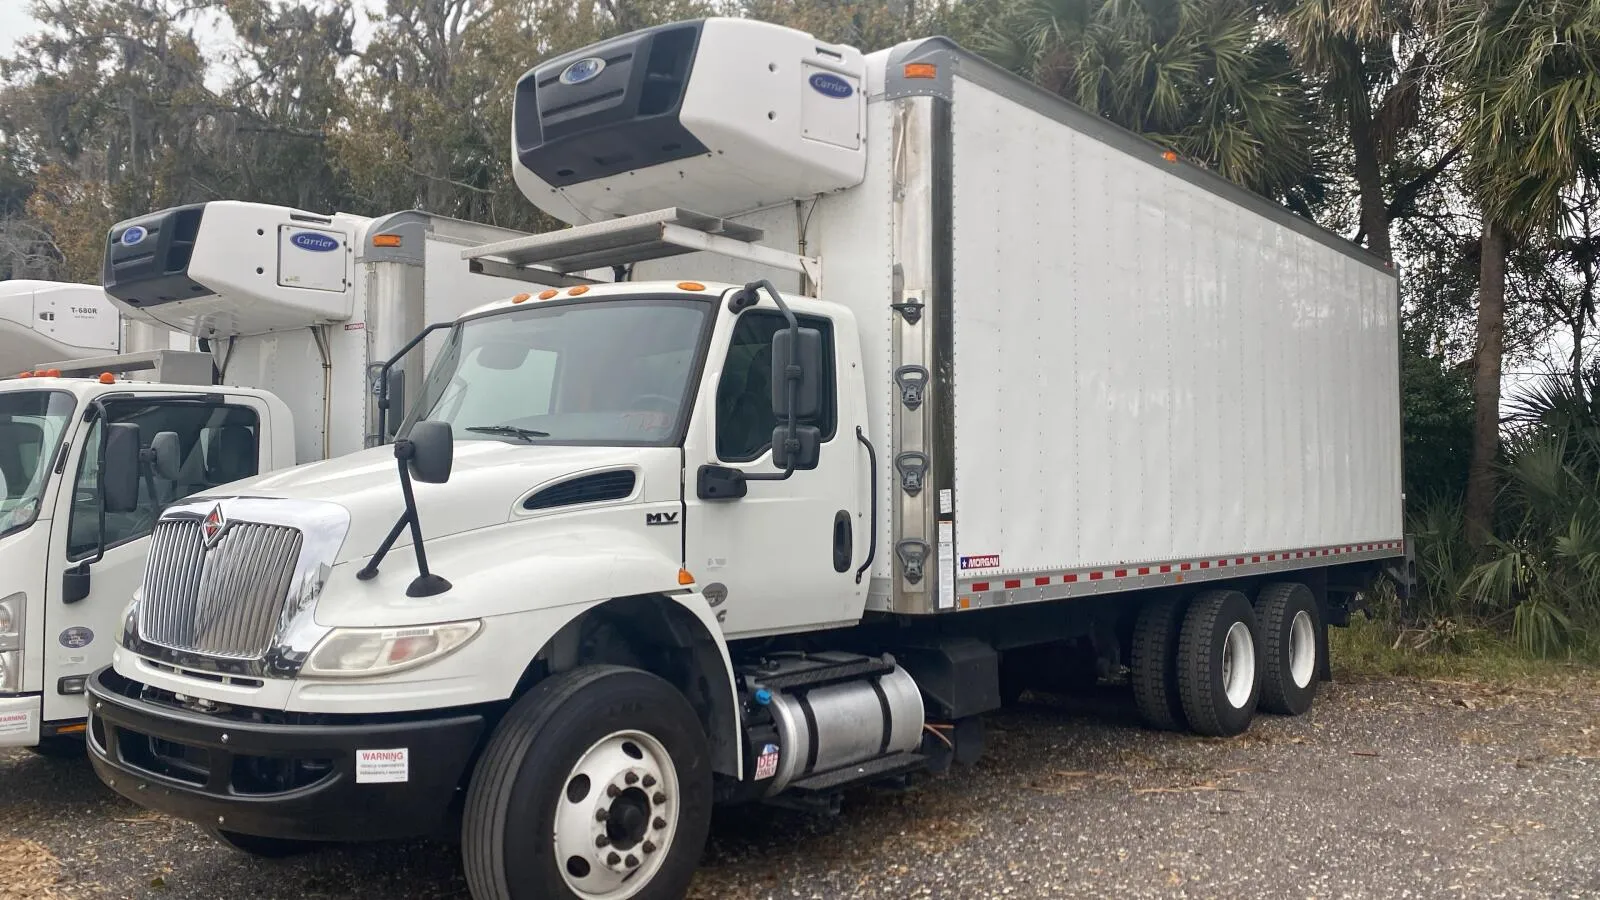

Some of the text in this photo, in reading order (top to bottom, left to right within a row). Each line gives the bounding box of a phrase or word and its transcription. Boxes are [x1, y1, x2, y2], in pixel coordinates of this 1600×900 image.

[815, 76, 848, 93] Carrier
[297, 235, 333, 247] Carrier
[70, 307, 97, 315] T-680R
[646, 512, 679, 525] MV
[968, 556, 999, 568] MORGAN
[362, 752, 404, 761] WARNING
[759, 753, 778, 768] DEF
